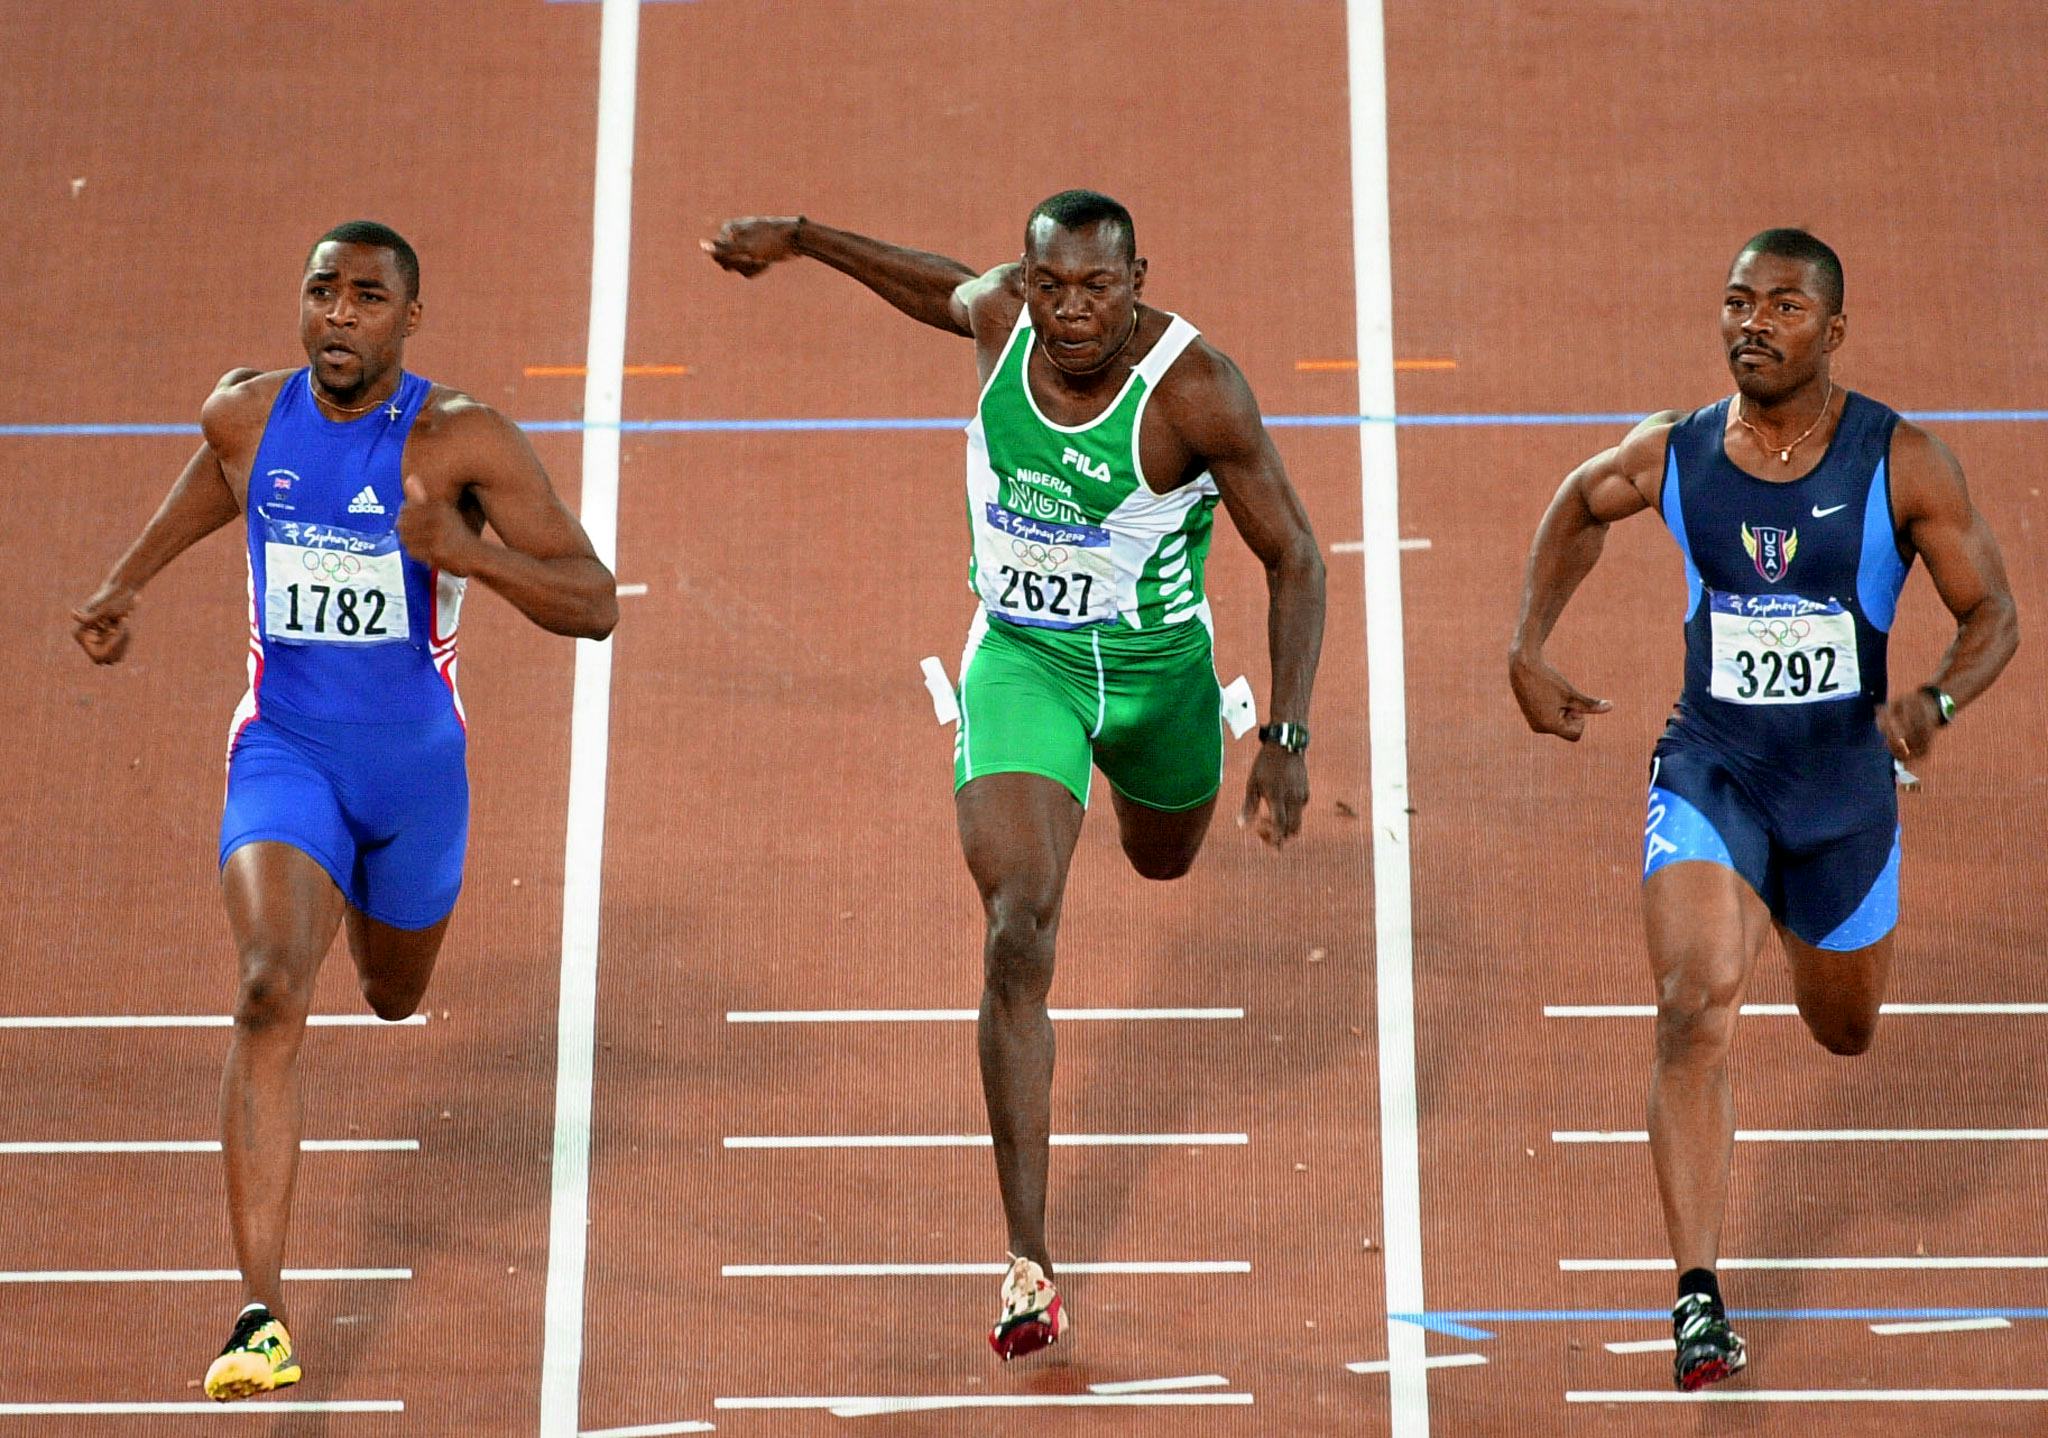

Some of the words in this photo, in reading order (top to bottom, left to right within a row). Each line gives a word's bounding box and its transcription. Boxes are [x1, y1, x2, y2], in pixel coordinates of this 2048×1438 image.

[1062, 447, 1111, 483] FILA
[1016, 468, 1072, 498] NIGERIA
[348, 504, 385, 514] adidas
[303, 526, 349, 551] Sydney
[1012, 517, 1056, 543] Sydney
[1763, 531, 1780, 570] USA
[999, 565, 1093, 617] 2627
[1747, 597, 1797, 616] Sydney
[286, 583, 387, 636] 1782
[1736, 647, 1839, 698] 3292
